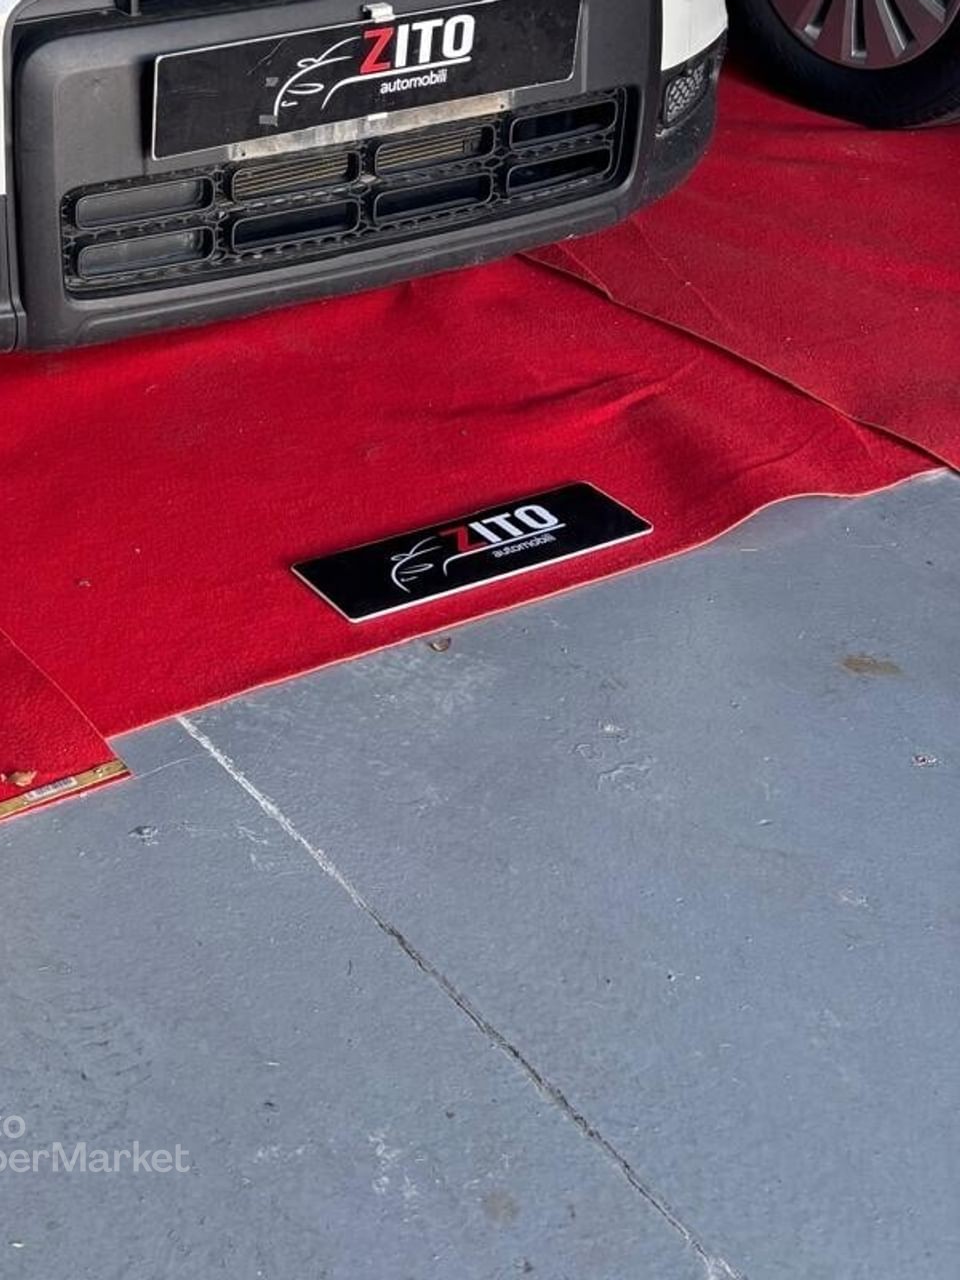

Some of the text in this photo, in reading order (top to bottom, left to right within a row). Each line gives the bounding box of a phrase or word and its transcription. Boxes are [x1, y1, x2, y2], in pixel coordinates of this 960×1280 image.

[360, 14, 475, 74] ZITO
[380, 68, 447, 94] automobili
[439, 505, 558, 552] ZITO
